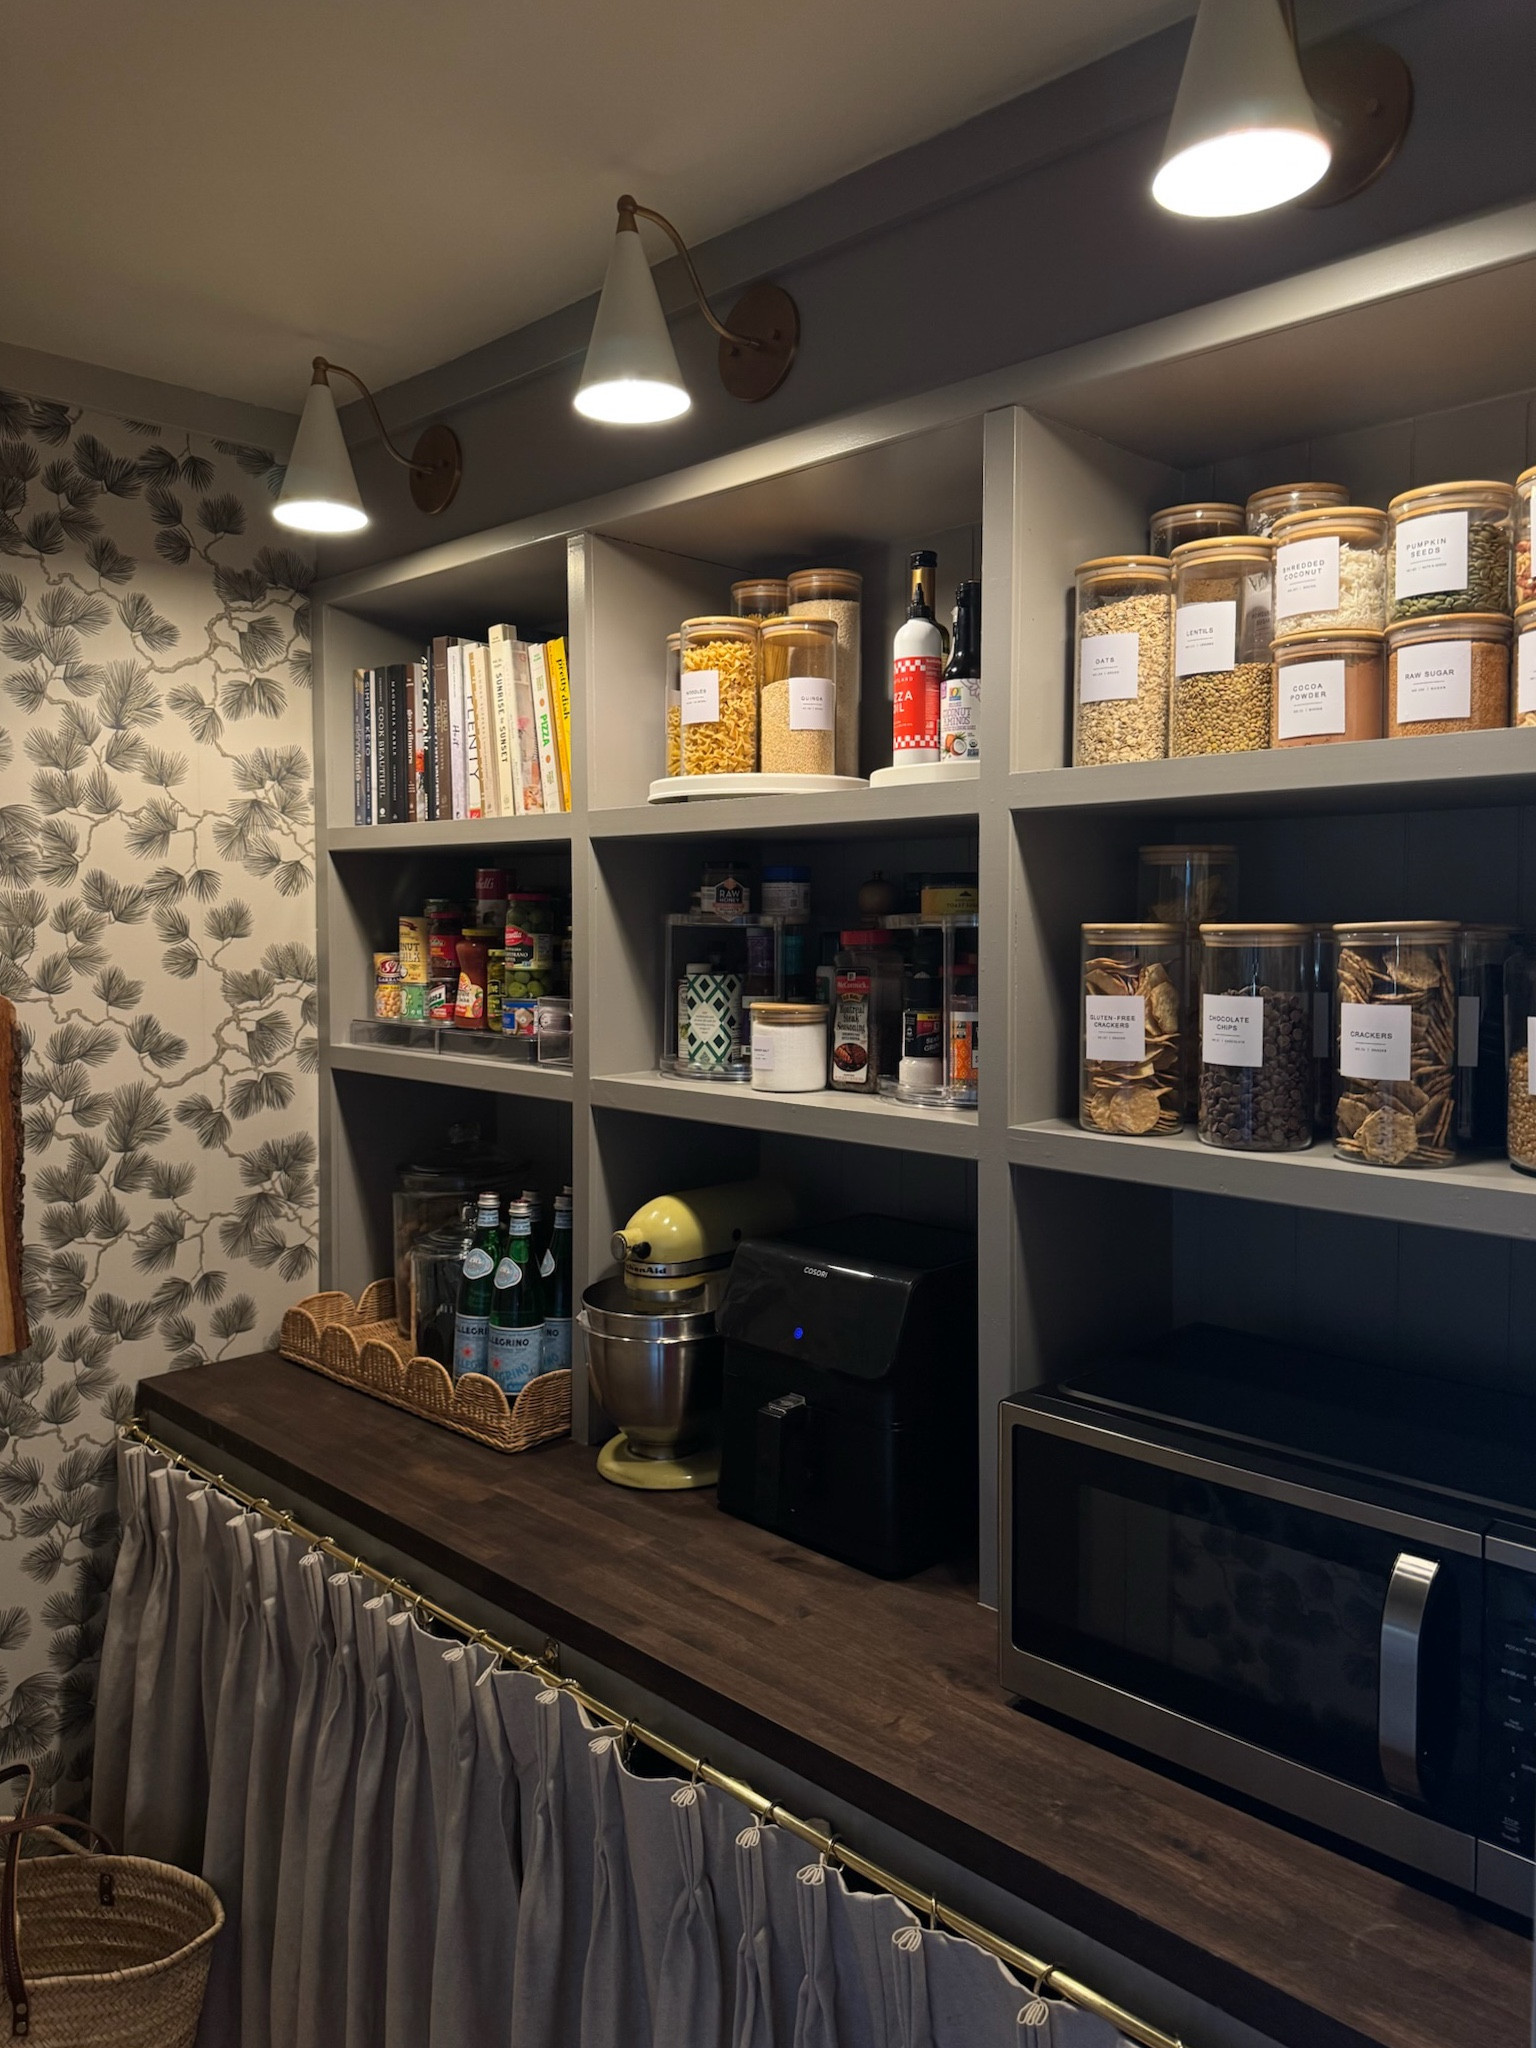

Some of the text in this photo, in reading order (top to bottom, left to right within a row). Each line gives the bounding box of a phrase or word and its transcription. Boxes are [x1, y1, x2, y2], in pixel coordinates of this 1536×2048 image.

[1406, 537, 1447, 550] PUMPKIN
[1410, 547, 1440, 558] SEEDS
[1282, 559, 1325, 574] SHREDDED
[1284, 567, 1322, 581] COCONUT
[1186, 627, 1214, 637] LENTILS
[1095, 657, 1115, 665] OATS
[1405, 669, 1455, 680] RAW SUGAR
[556, 658, 570, 720] pretty dish
[1292, 683, 1323, 692] COCOA
[495, 672, 505, 715] SUNRISE
[1290, 691, 1327, 701] POWDER
[540, 713, 550, 747] PIZZA
[499, 726, 508, 763] SUNSET
[378, 740, 386, 798] BEAUTIFUL
[719, 889, 741, 898] RAW
[1090, 1014, 1136, 1022] GLUTEN-FREE
[1209, 1015, 1249, 1024] CHOCOLATE
[1350, 1031, 1393, 1040] CRACKERS
[803, 1266, 829, 1279] COSORI
